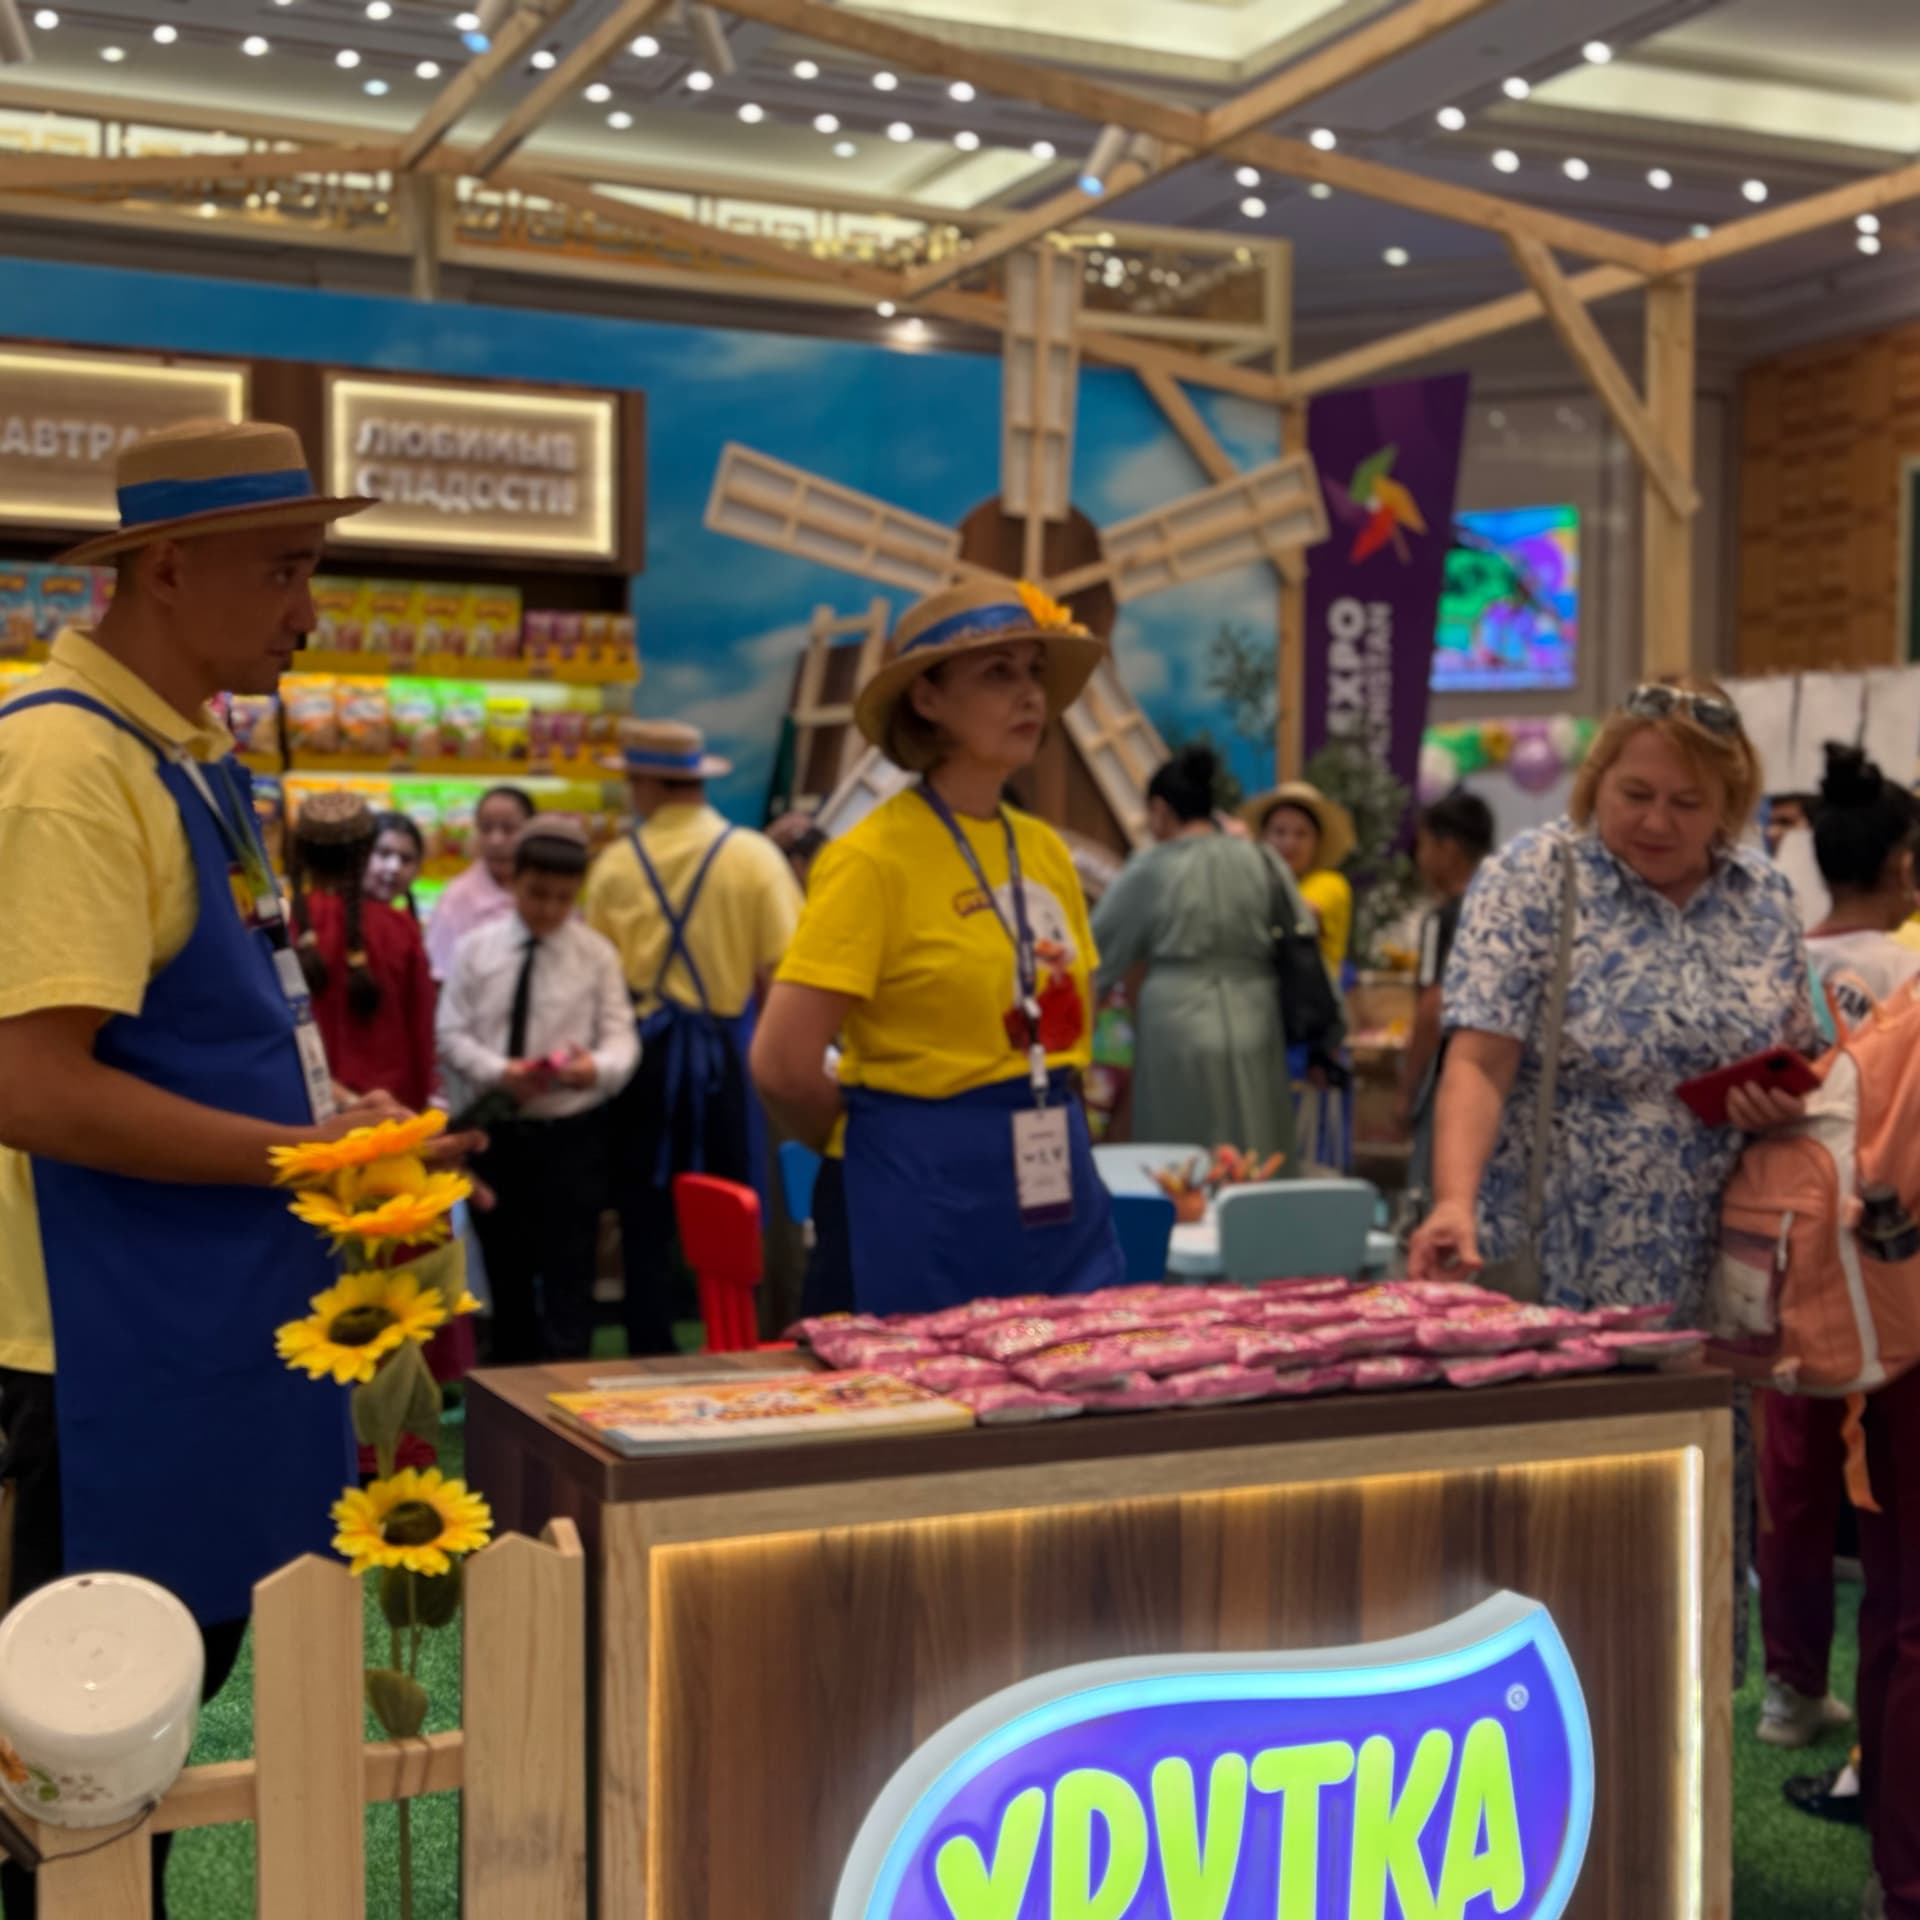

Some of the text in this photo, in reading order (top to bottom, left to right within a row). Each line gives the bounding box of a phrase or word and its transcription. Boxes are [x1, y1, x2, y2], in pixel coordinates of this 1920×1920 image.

[0, 416, 144, 461] АВТРА
[356, 417, 576, 470] ЛЮБИМЫЕ
[356, 463, 576, 516] СЛАДОСТИ
